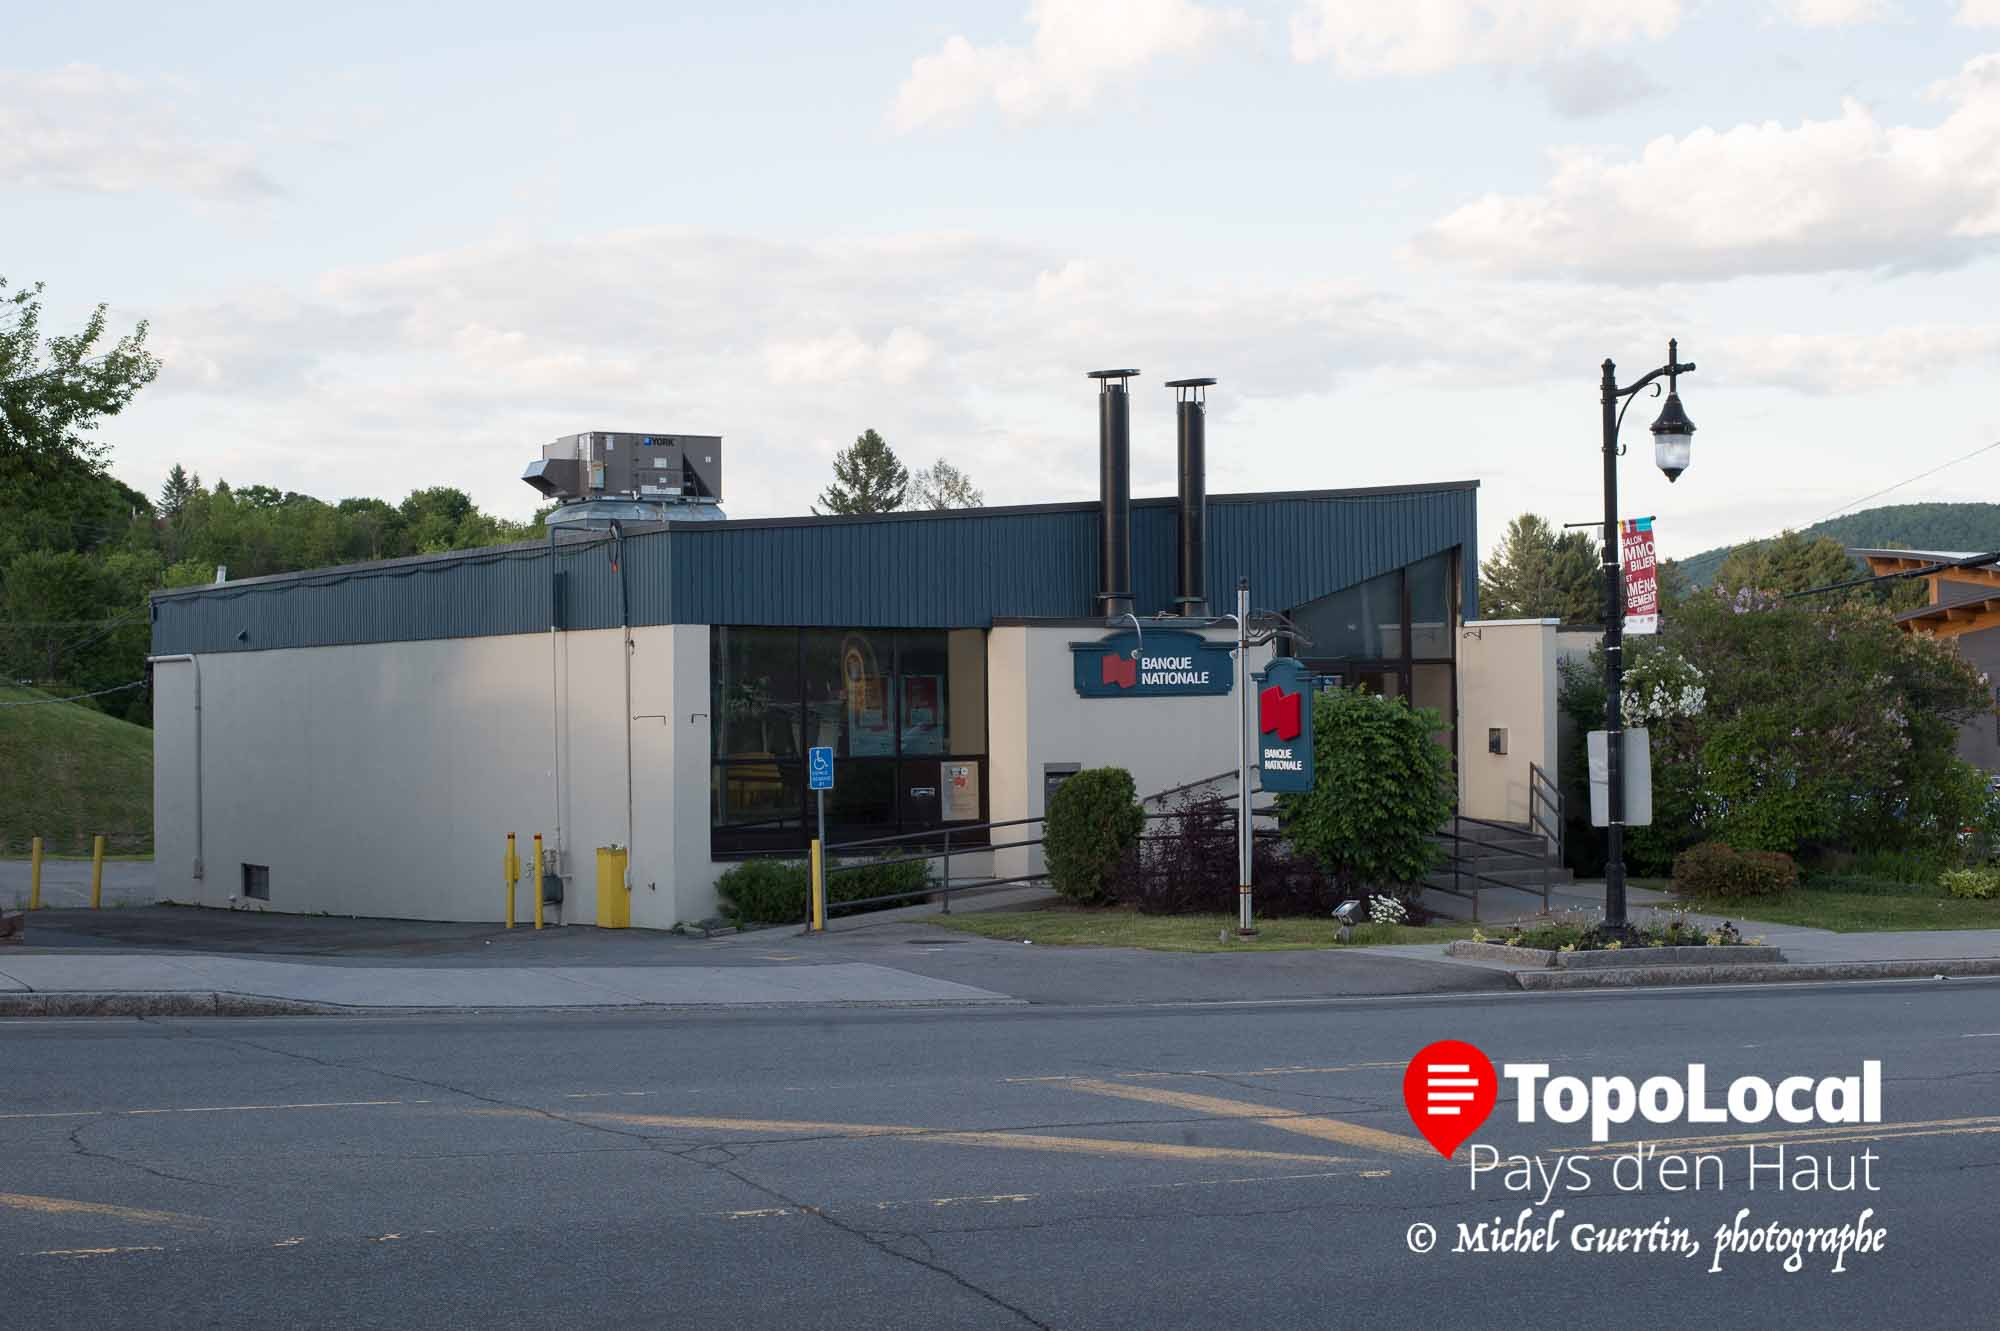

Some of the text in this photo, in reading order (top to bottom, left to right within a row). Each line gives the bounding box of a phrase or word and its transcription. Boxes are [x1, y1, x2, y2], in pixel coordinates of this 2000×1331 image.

[652, 438, 675, 447] YORK
[1624, 541, 1655, 562] MMO
[1631, 556, 1656, 572] BILIER
[1628, 591, 1656, 608] GEMENT
[1141, 656, 1192, 670] BANQUE
[1141, 671, 1209, 685] NATIONALE
[1264, 748, 1292, 759] BANQUE
[1264, 760, 1303, 771] NATIONALE
